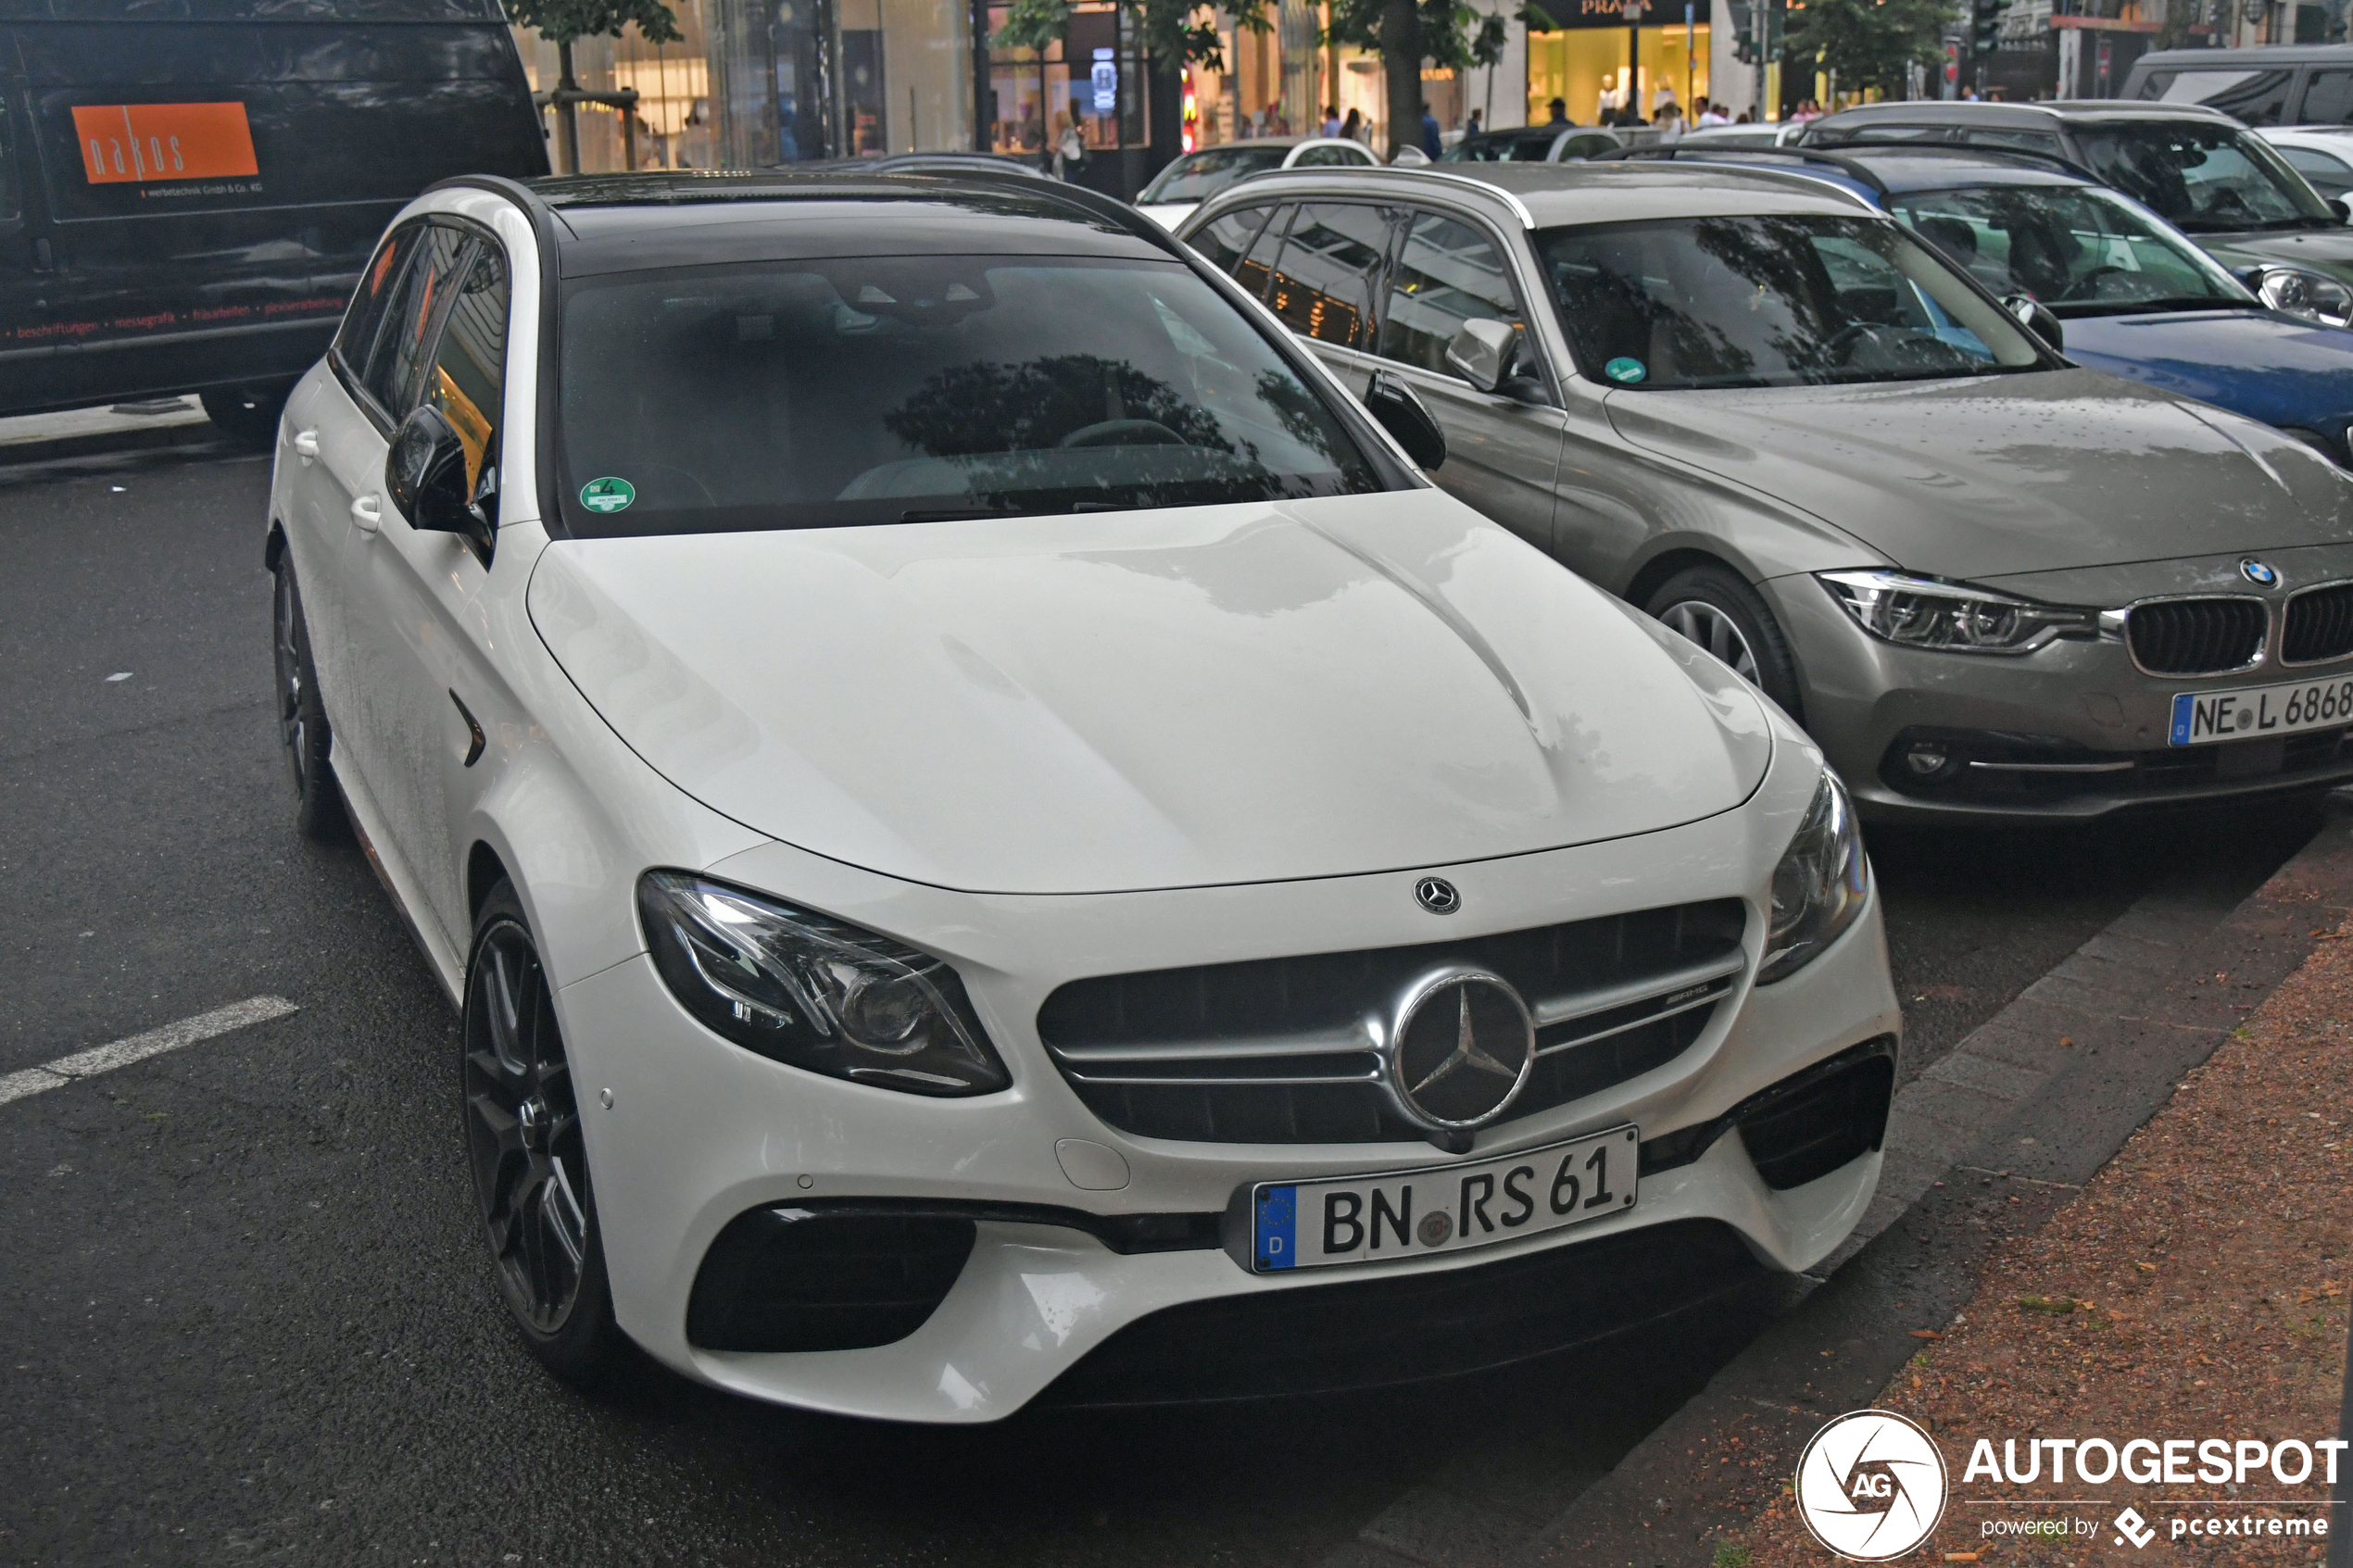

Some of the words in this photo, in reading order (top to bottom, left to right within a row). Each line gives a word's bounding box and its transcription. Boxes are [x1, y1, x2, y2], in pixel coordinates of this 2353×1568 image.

[1581, 0, 1653, 15] PRAA
[90, 106, 183, 181] nakos
[148, 186, 201, 197] werbetechnik
[250, 182, 263, 192] KG
[17, 321, 99, 338] beschriftungen
[115, 311, 176, 329] messegrafik
[600, 480, 615, 495] 4
[2194, 696, 2237, 737] NE
[2258, 694, 2277, 730] L
[2285, 682, 2353, 725] 6868
[1678, 985, 1708, 1000] AMG
[1269, 1236, 1283, 1254] D
[1323, 1185, 1412, 1254] BN
[1458, 1166, 1535, 1237] RS
[1549, 1146, 1613, 1215] 61
